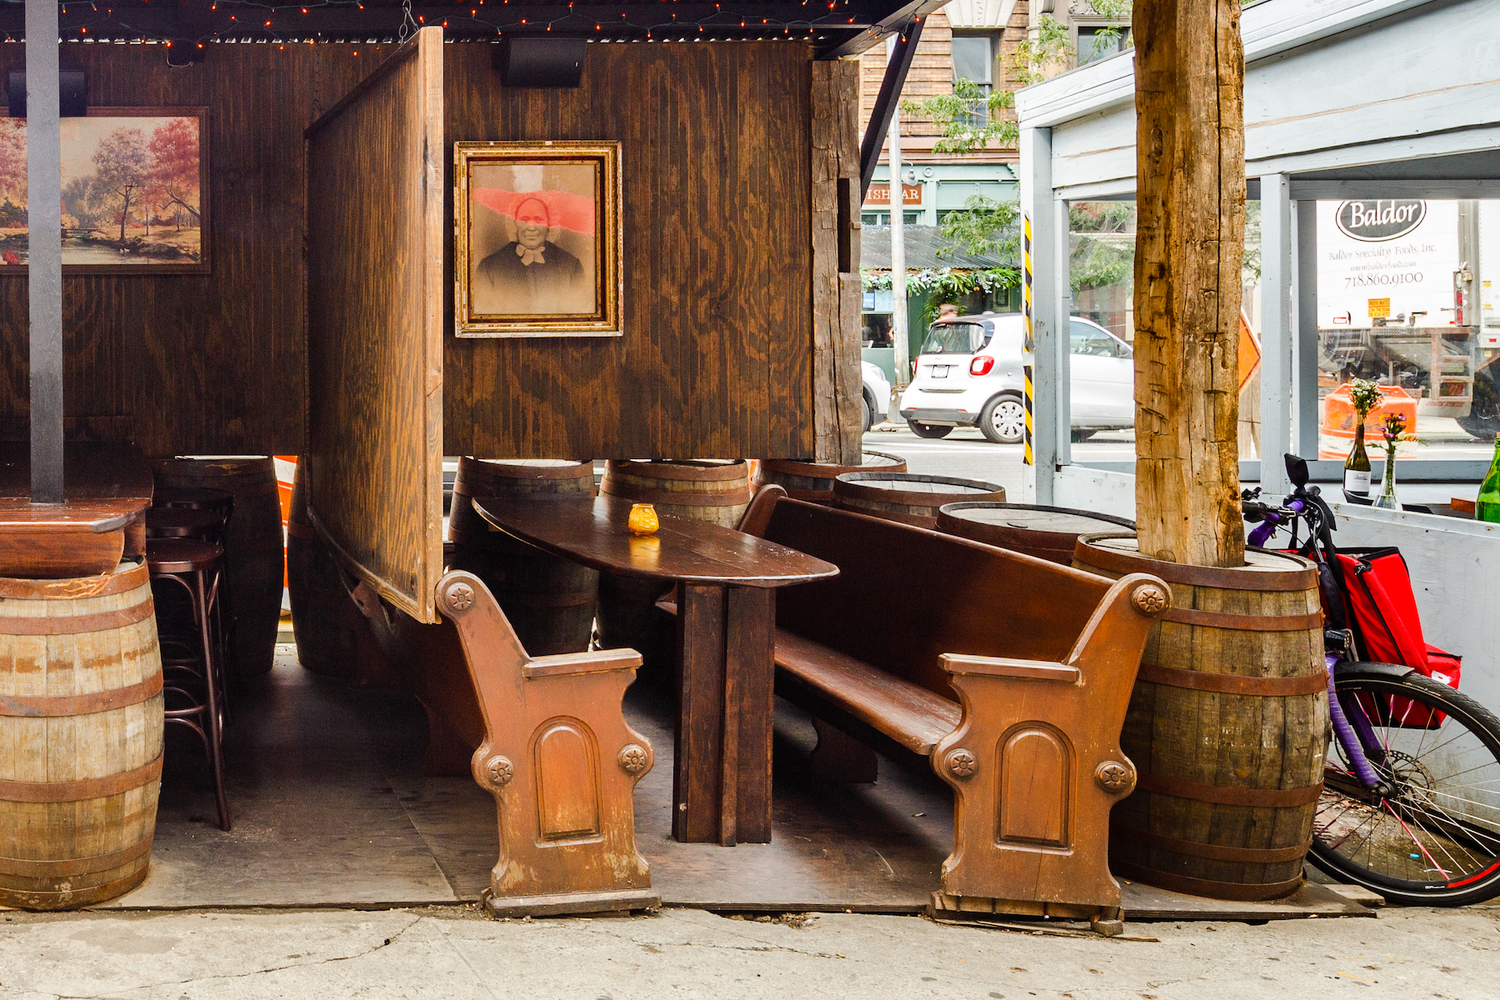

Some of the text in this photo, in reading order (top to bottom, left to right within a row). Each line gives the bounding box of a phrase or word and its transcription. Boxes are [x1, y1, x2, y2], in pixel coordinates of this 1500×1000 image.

[867, 189, 919, 200] ISH AR
[1349, 200, 1418, 229] Baldor
[1328, 243, 1437, 261] Baldor Specialty Foods, Inc.
[1344, 272, 1424, 290] 718.860.9100
